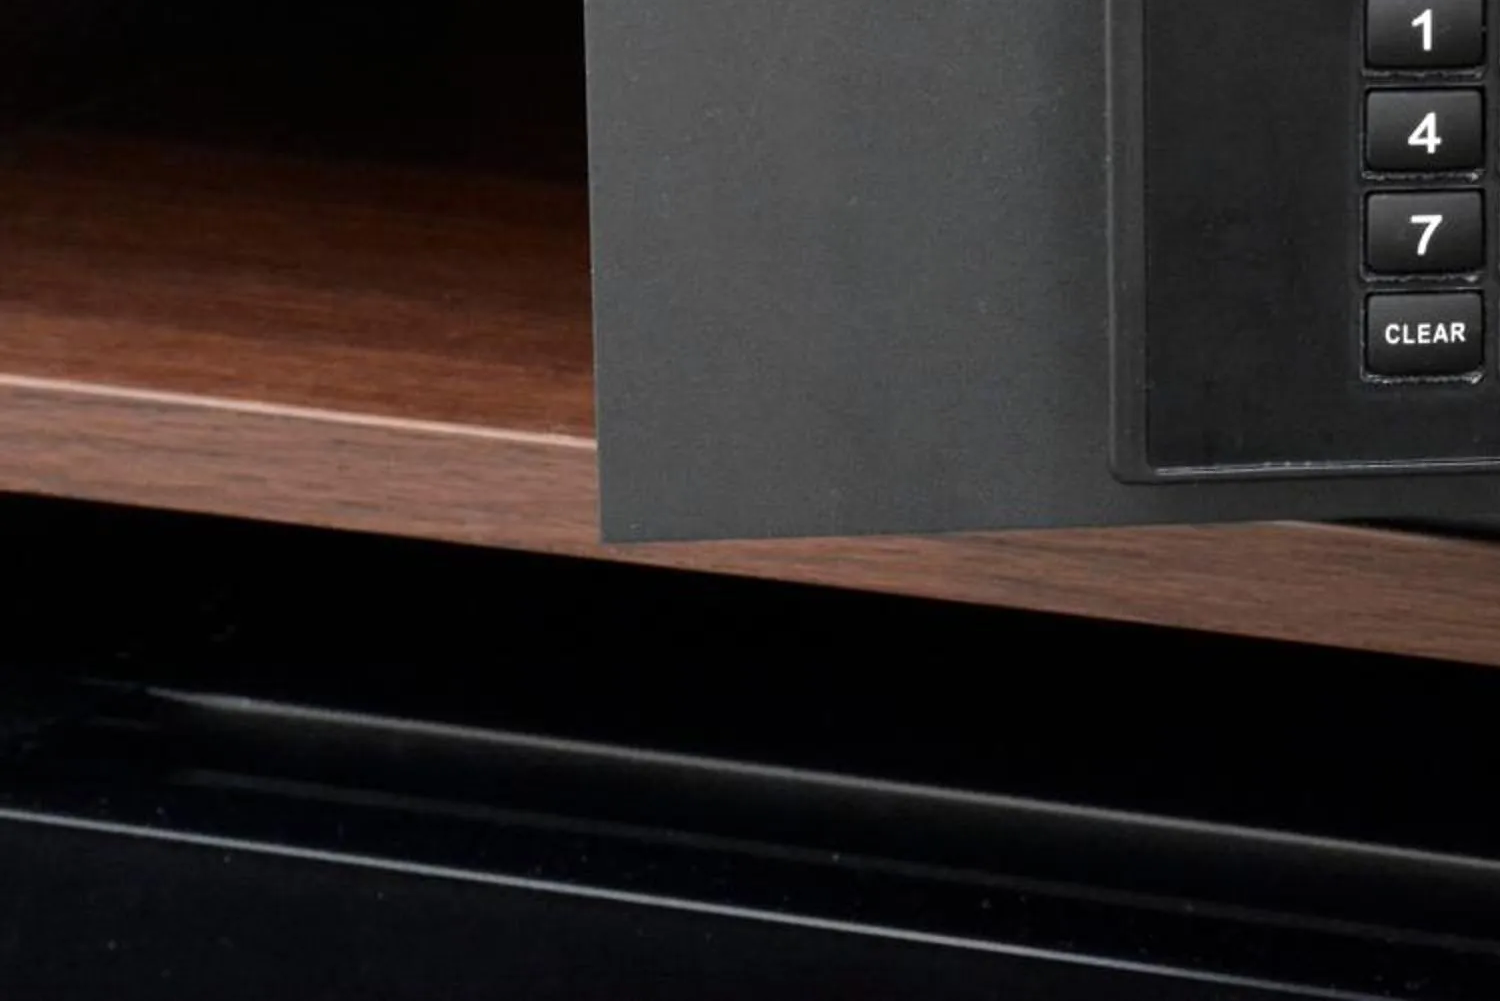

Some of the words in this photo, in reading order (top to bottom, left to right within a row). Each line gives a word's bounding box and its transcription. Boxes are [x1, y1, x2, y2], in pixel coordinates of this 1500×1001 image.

[1410, 8, 1434, 51] 1
[1407, 111, 1442, 154] 4
[1409, 214, 1443, 256] 7
[1384, 321, 1466, 345] CLEAR
